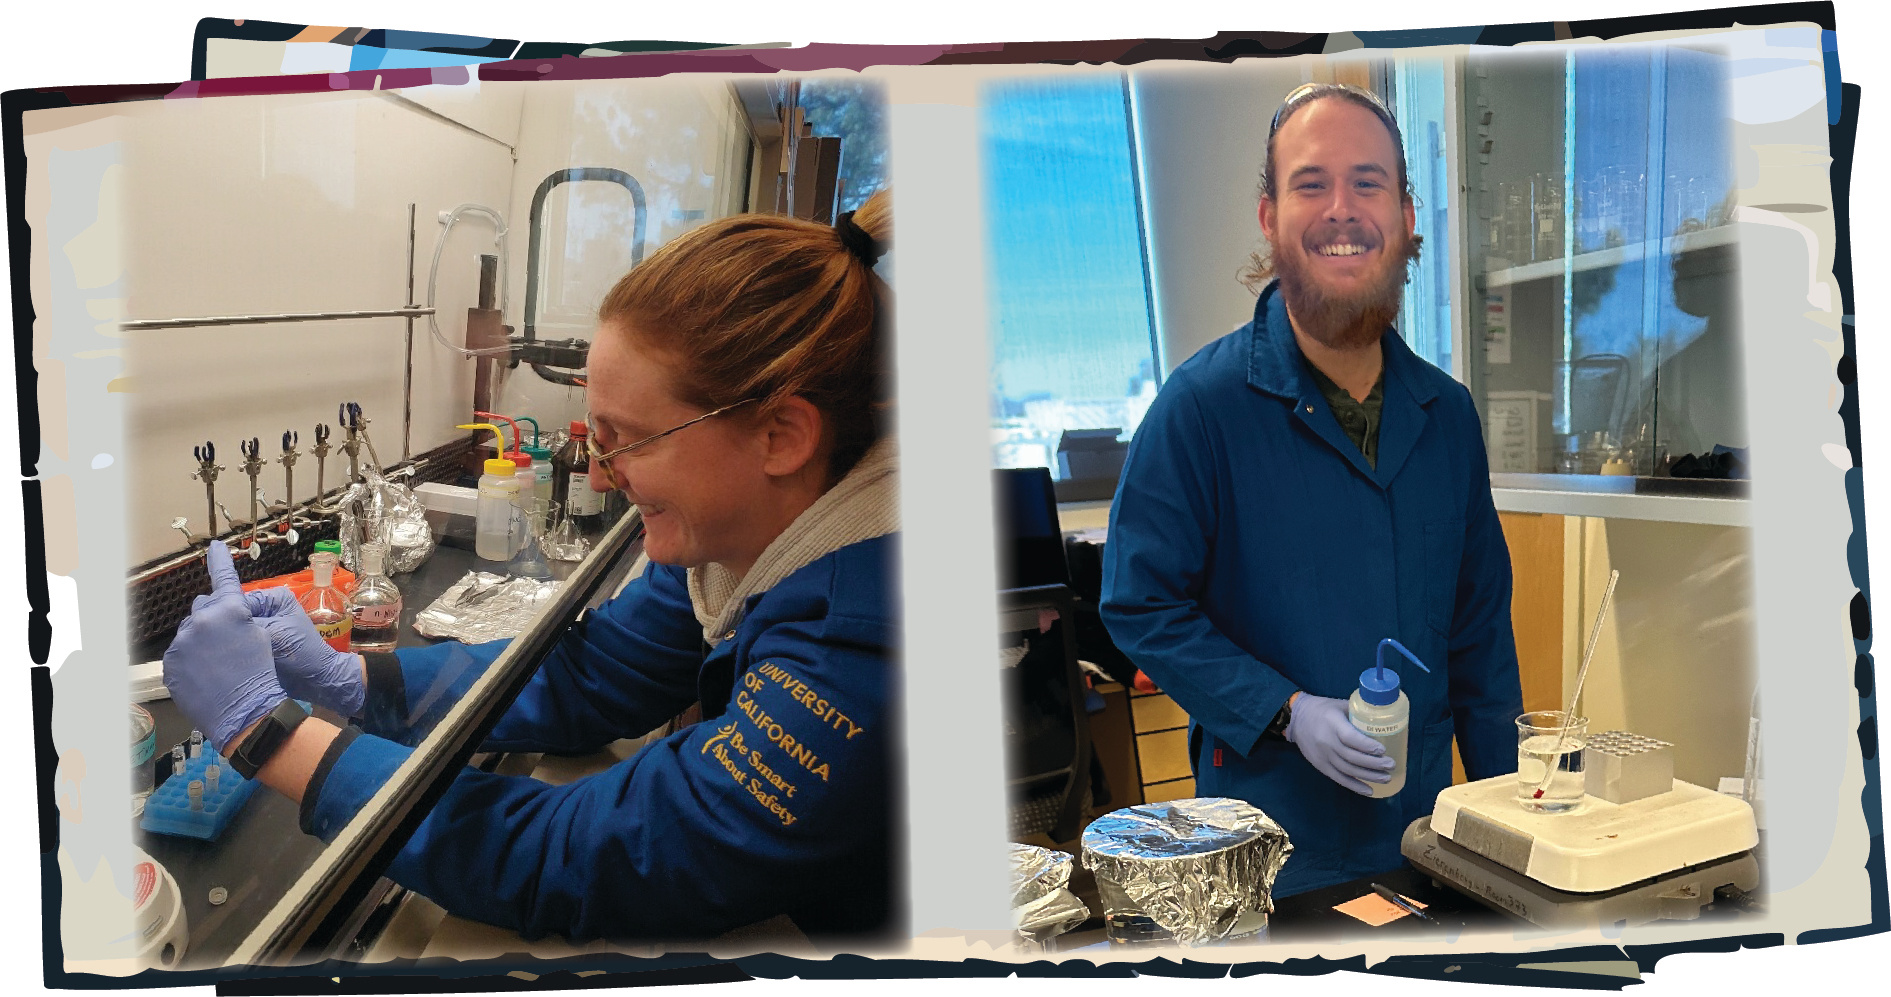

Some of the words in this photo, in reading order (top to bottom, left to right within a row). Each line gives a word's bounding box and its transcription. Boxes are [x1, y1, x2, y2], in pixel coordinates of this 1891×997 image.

[744, 672, 765, 693] OF
[758, 661, 863, 740] UNIVERSITY
[730, 731, 749, 755] Be
[747, 751, 798, 798] Smart
[736, 690, 831, 782] CALIFORNIA
[1374, 725, 1399, 733] WATER
[712, 743, 748, 785] About
[745, 778, 798, 826] Safety
